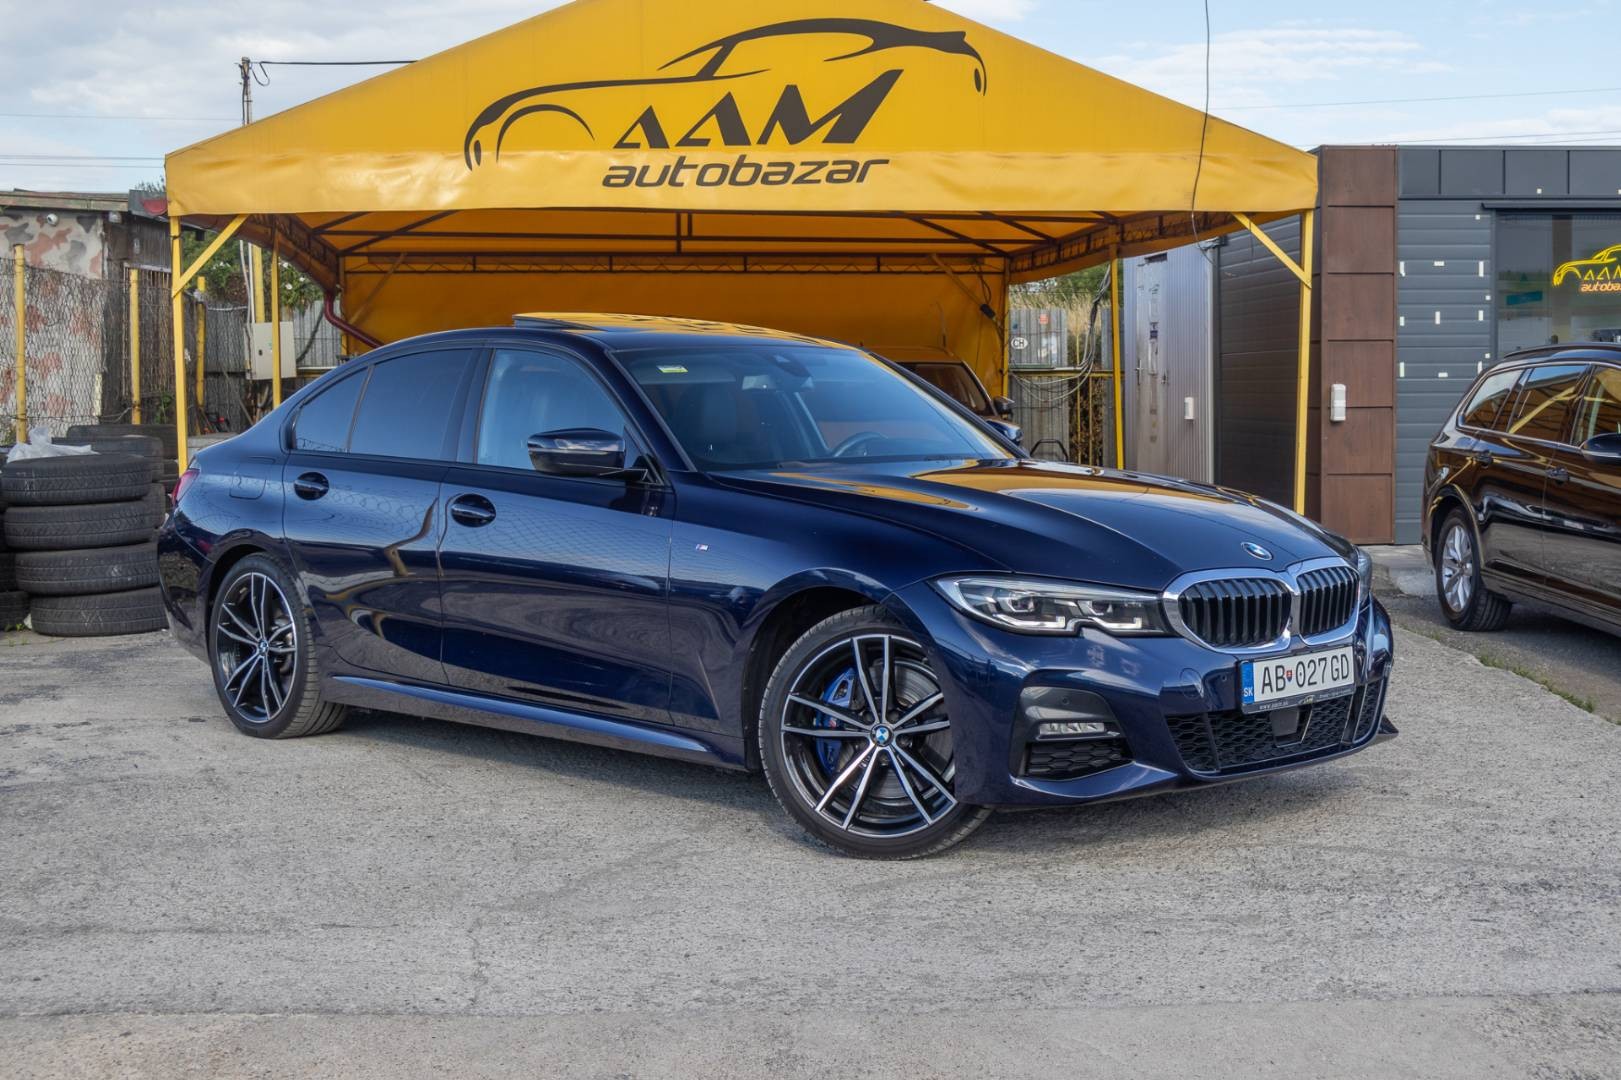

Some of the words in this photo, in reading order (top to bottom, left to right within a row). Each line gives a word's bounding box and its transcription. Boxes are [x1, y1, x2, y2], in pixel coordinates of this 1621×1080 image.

[613, 69, 904, 148] AAM
[602, 154, 890, 188] autobazar
[1581, 281, 1621, 293] autoba
[1243, 687, 1253, 697] SK
